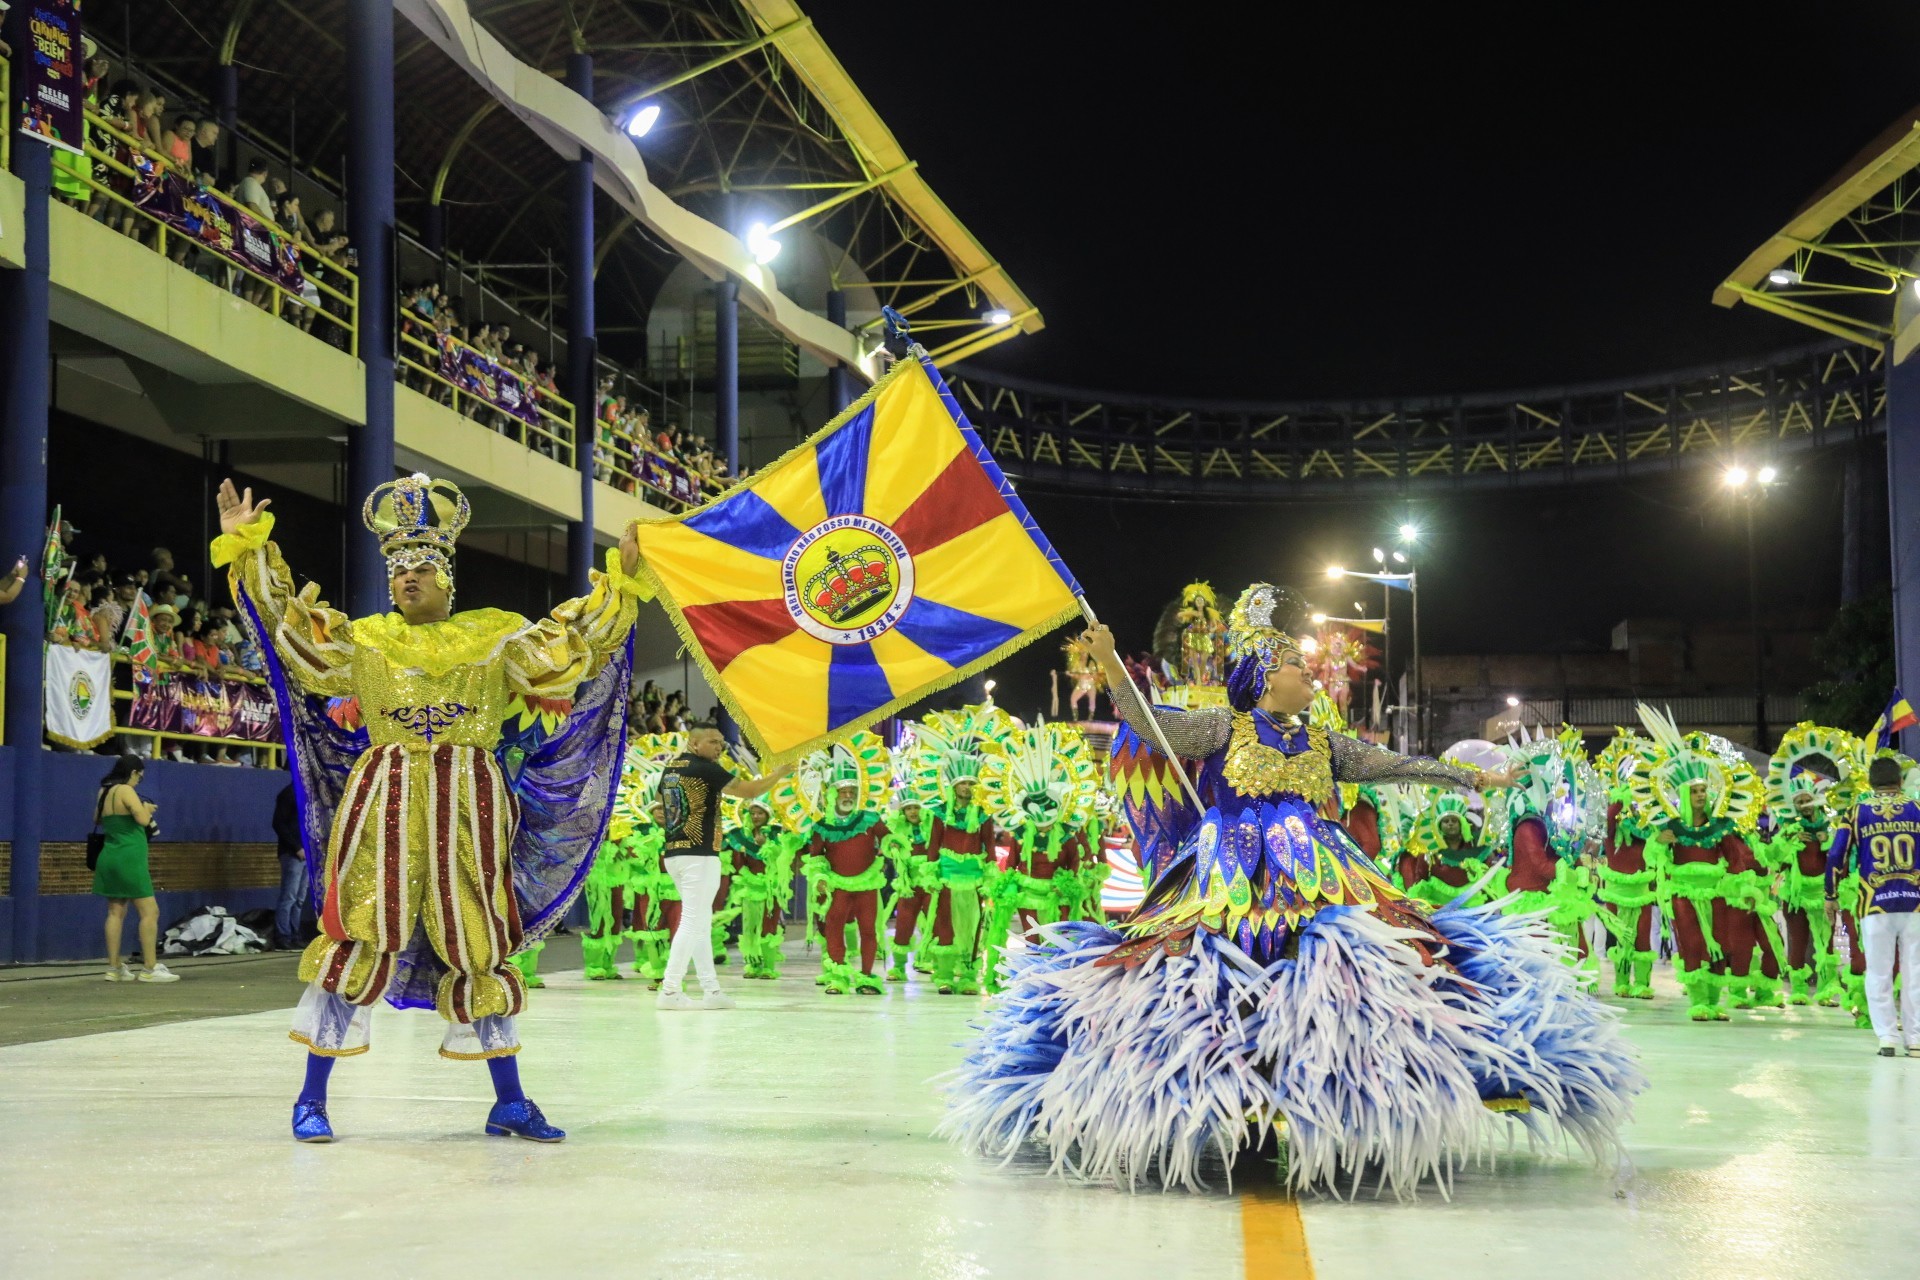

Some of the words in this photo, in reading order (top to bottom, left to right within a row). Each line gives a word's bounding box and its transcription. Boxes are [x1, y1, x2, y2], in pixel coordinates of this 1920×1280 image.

[31, 19, 71, 50] CARNAVAL
[38, 40, 65, 62] BELÉM
[43, 85, 69, 103] BELÉM
[785, 549, 800, 591] RANCHO
[797, 532, 816, 550] NÃO
[816, 517, 850, 535] POSSO
[853, 518, 868, 529] ME
[857, 612, 896, 640] 1934
[1870, 833, 1916, 871] 90
